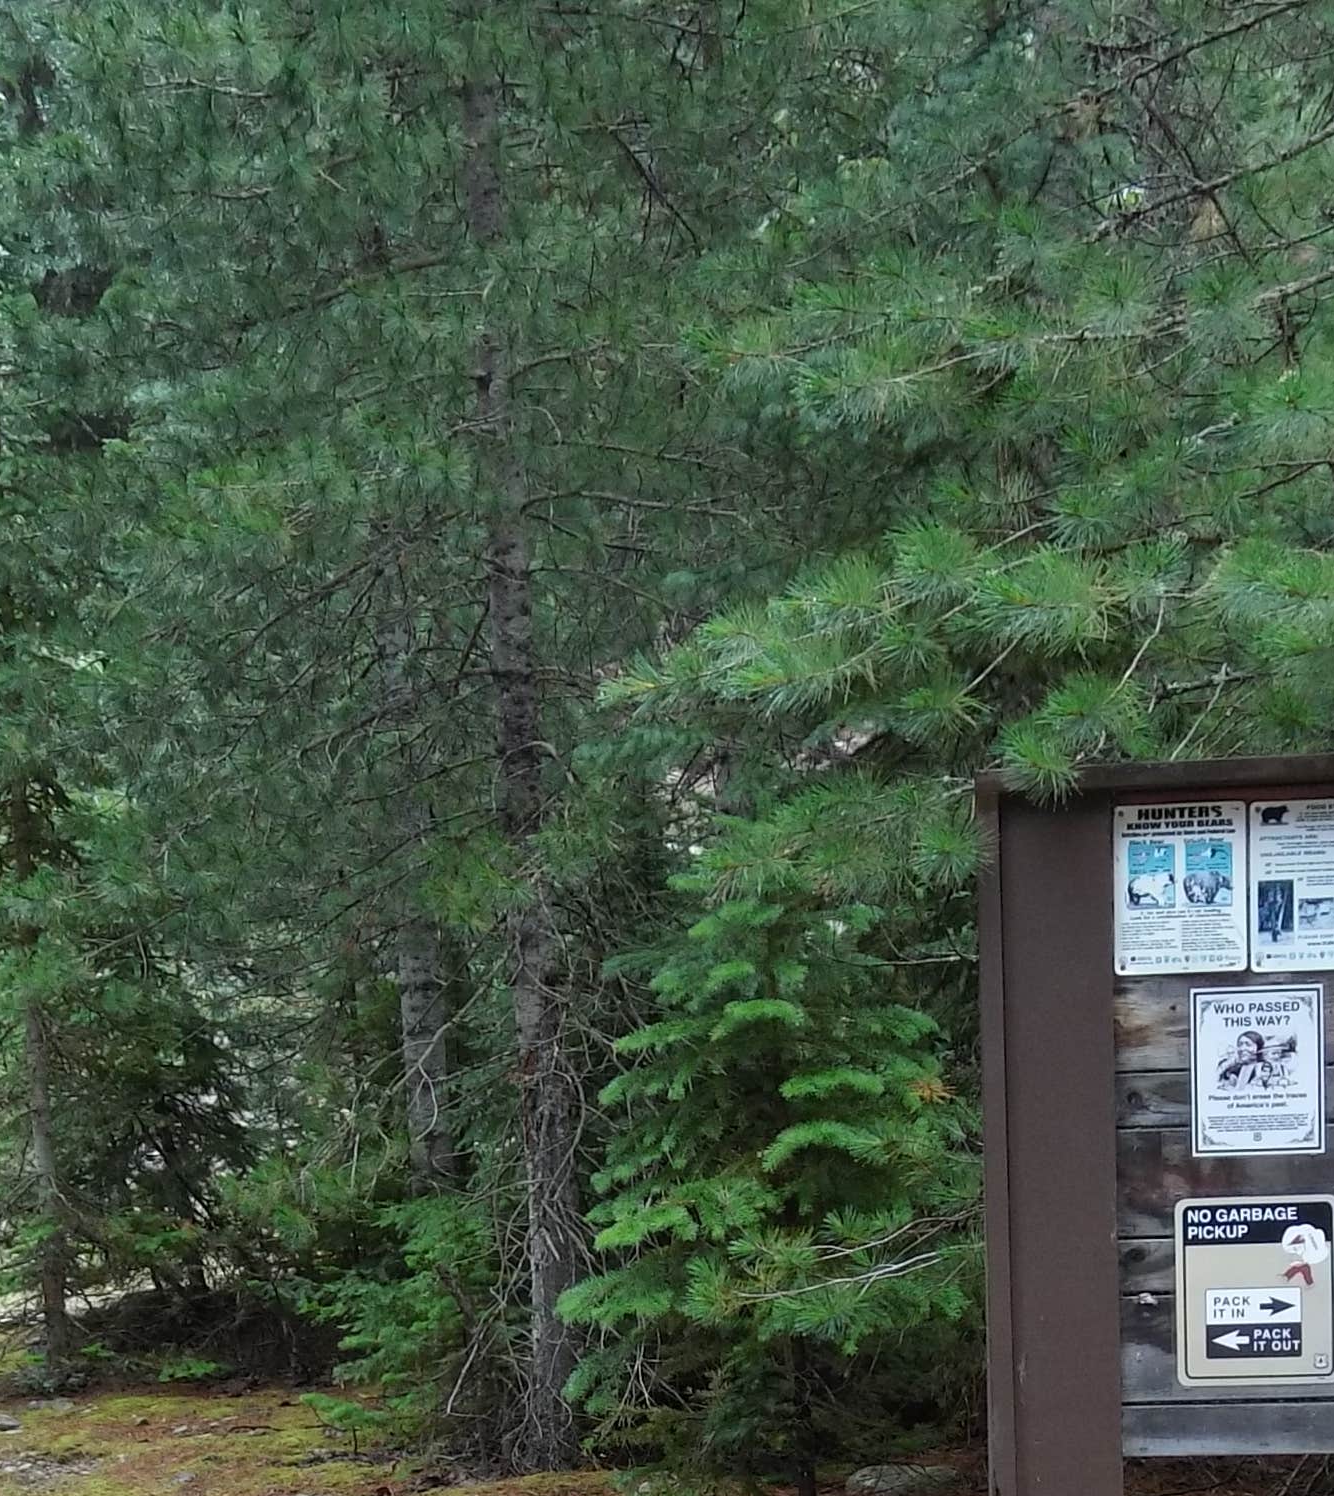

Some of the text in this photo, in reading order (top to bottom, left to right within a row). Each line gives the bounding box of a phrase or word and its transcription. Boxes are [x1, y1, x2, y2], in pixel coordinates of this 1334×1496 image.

[1137, 805, 1223, 820] HUNTERS
[1127, 818, 1234, 830] KNOW YOUR BEARS
[1214, 1001, 1300, 1014] WHO PASSED
[1223, 1015, 1291, 1027] THIS WAY?
[1187, 1207, 1298, 1223] NO GARBAGE
[1187, 1225, 1249, 1240] PICKUP
[1213, 1296, 1251, 1306] PACK
[1213, 1308, 1245, 1318] IT IN
[1253, 1328, 1292, 1339] PACK
[1253, 1340, 1300, 1351] IT OUT
